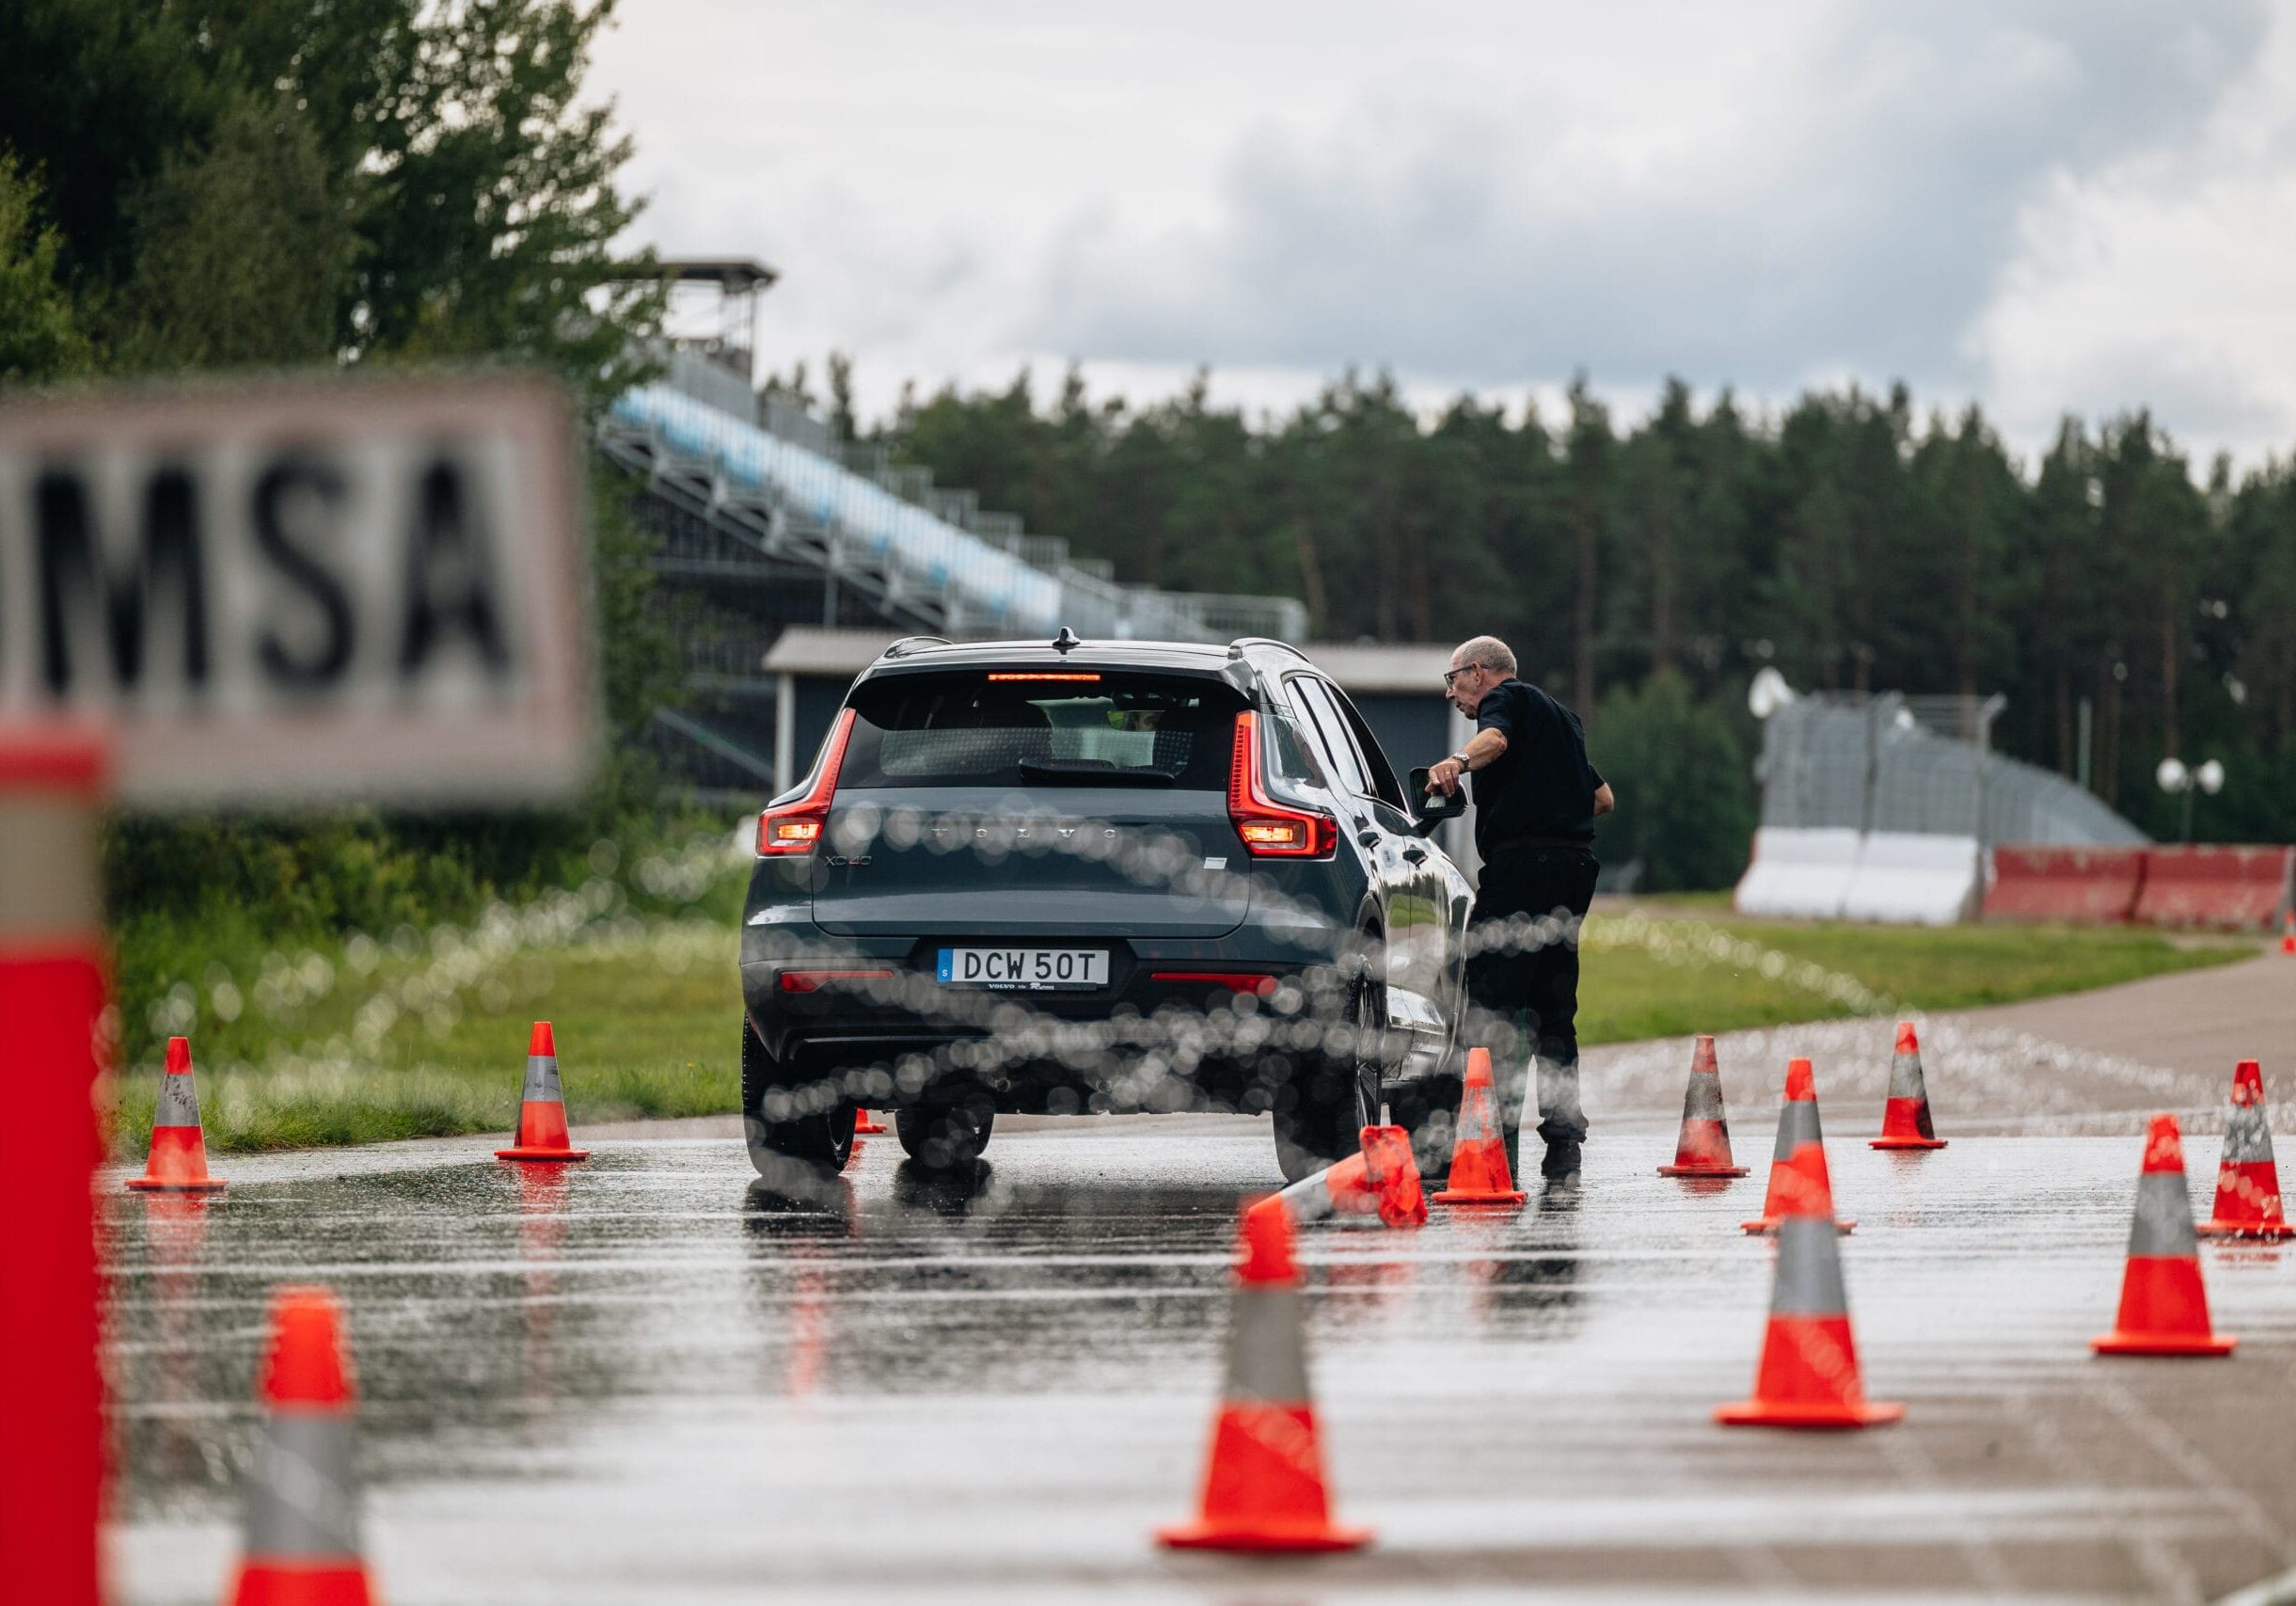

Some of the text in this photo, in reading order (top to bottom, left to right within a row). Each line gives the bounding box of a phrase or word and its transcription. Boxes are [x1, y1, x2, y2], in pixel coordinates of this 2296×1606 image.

[942, 969, 948, 978] S
[964, 951, 1096, 980] DCW 50T
